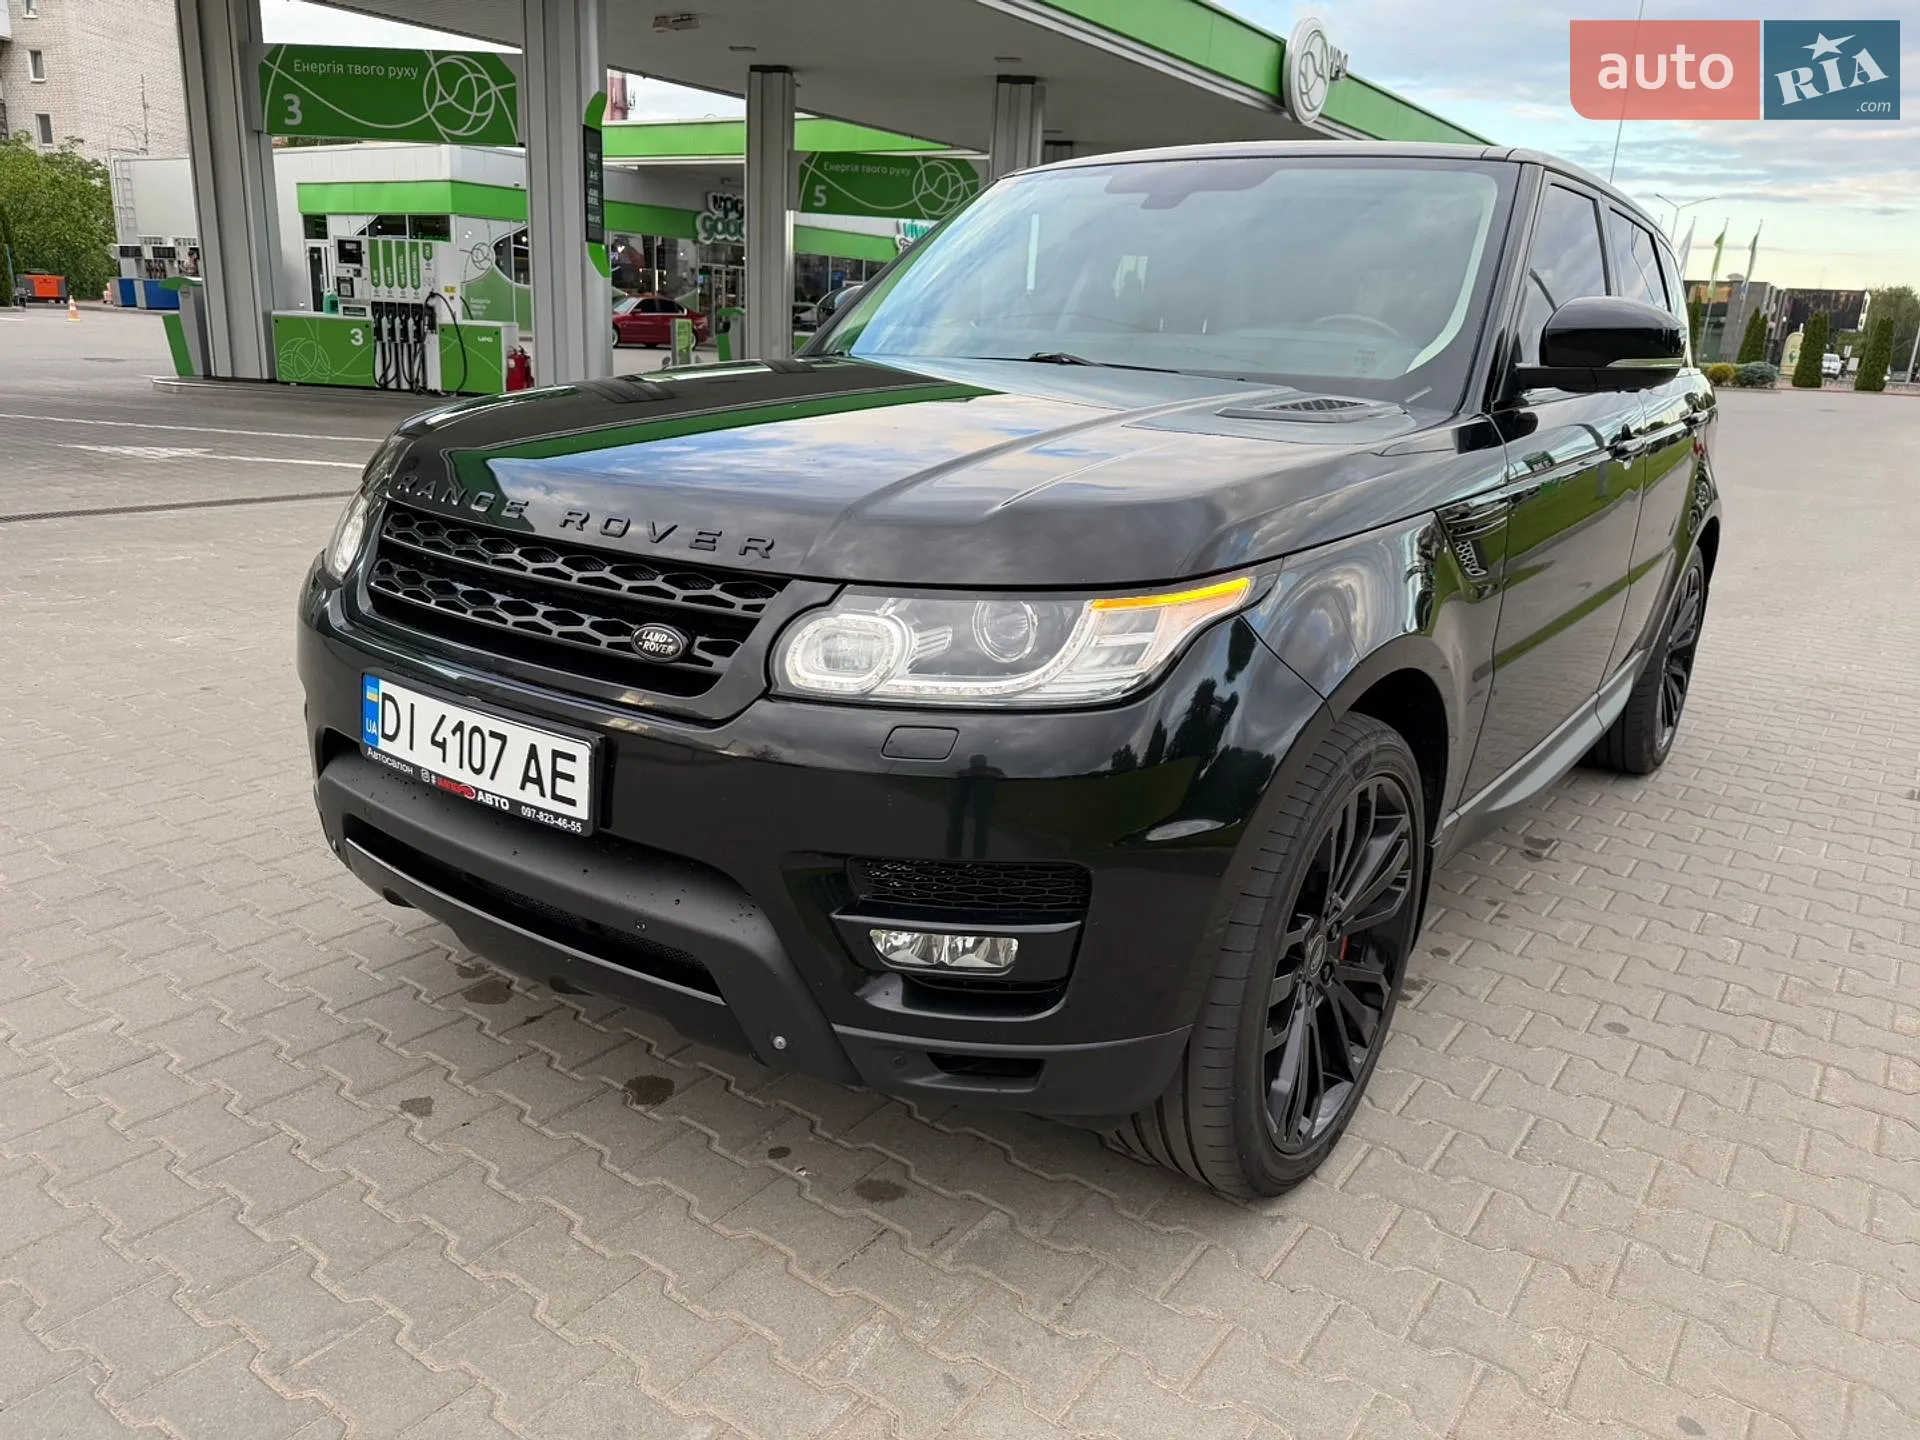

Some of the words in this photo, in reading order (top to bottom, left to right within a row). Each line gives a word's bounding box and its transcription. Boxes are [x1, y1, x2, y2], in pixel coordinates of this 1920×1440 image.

[293, 59, 344, 75] Енергія
[349, 63, 385, 77] твого
[388, 66, 418, 80] руху
[283, 93, 303, 126] 3
[823, 160, 859, 175] Енергія
[813, 185, 827, 207] 5
[350, 328, 364, 346] 3
[397, 475, 530, 519] RANGE
[558, 508, 774, 560] ROVER
[366, 718, 378, 736] UA
[381, 692, 415, 750] DI
[430, 714, 508, 781] 4107
[519, 743, 578, 807] AE
[366, 747, 414, 775] Автосалон
[476, 790, 510, 811] АВТО
